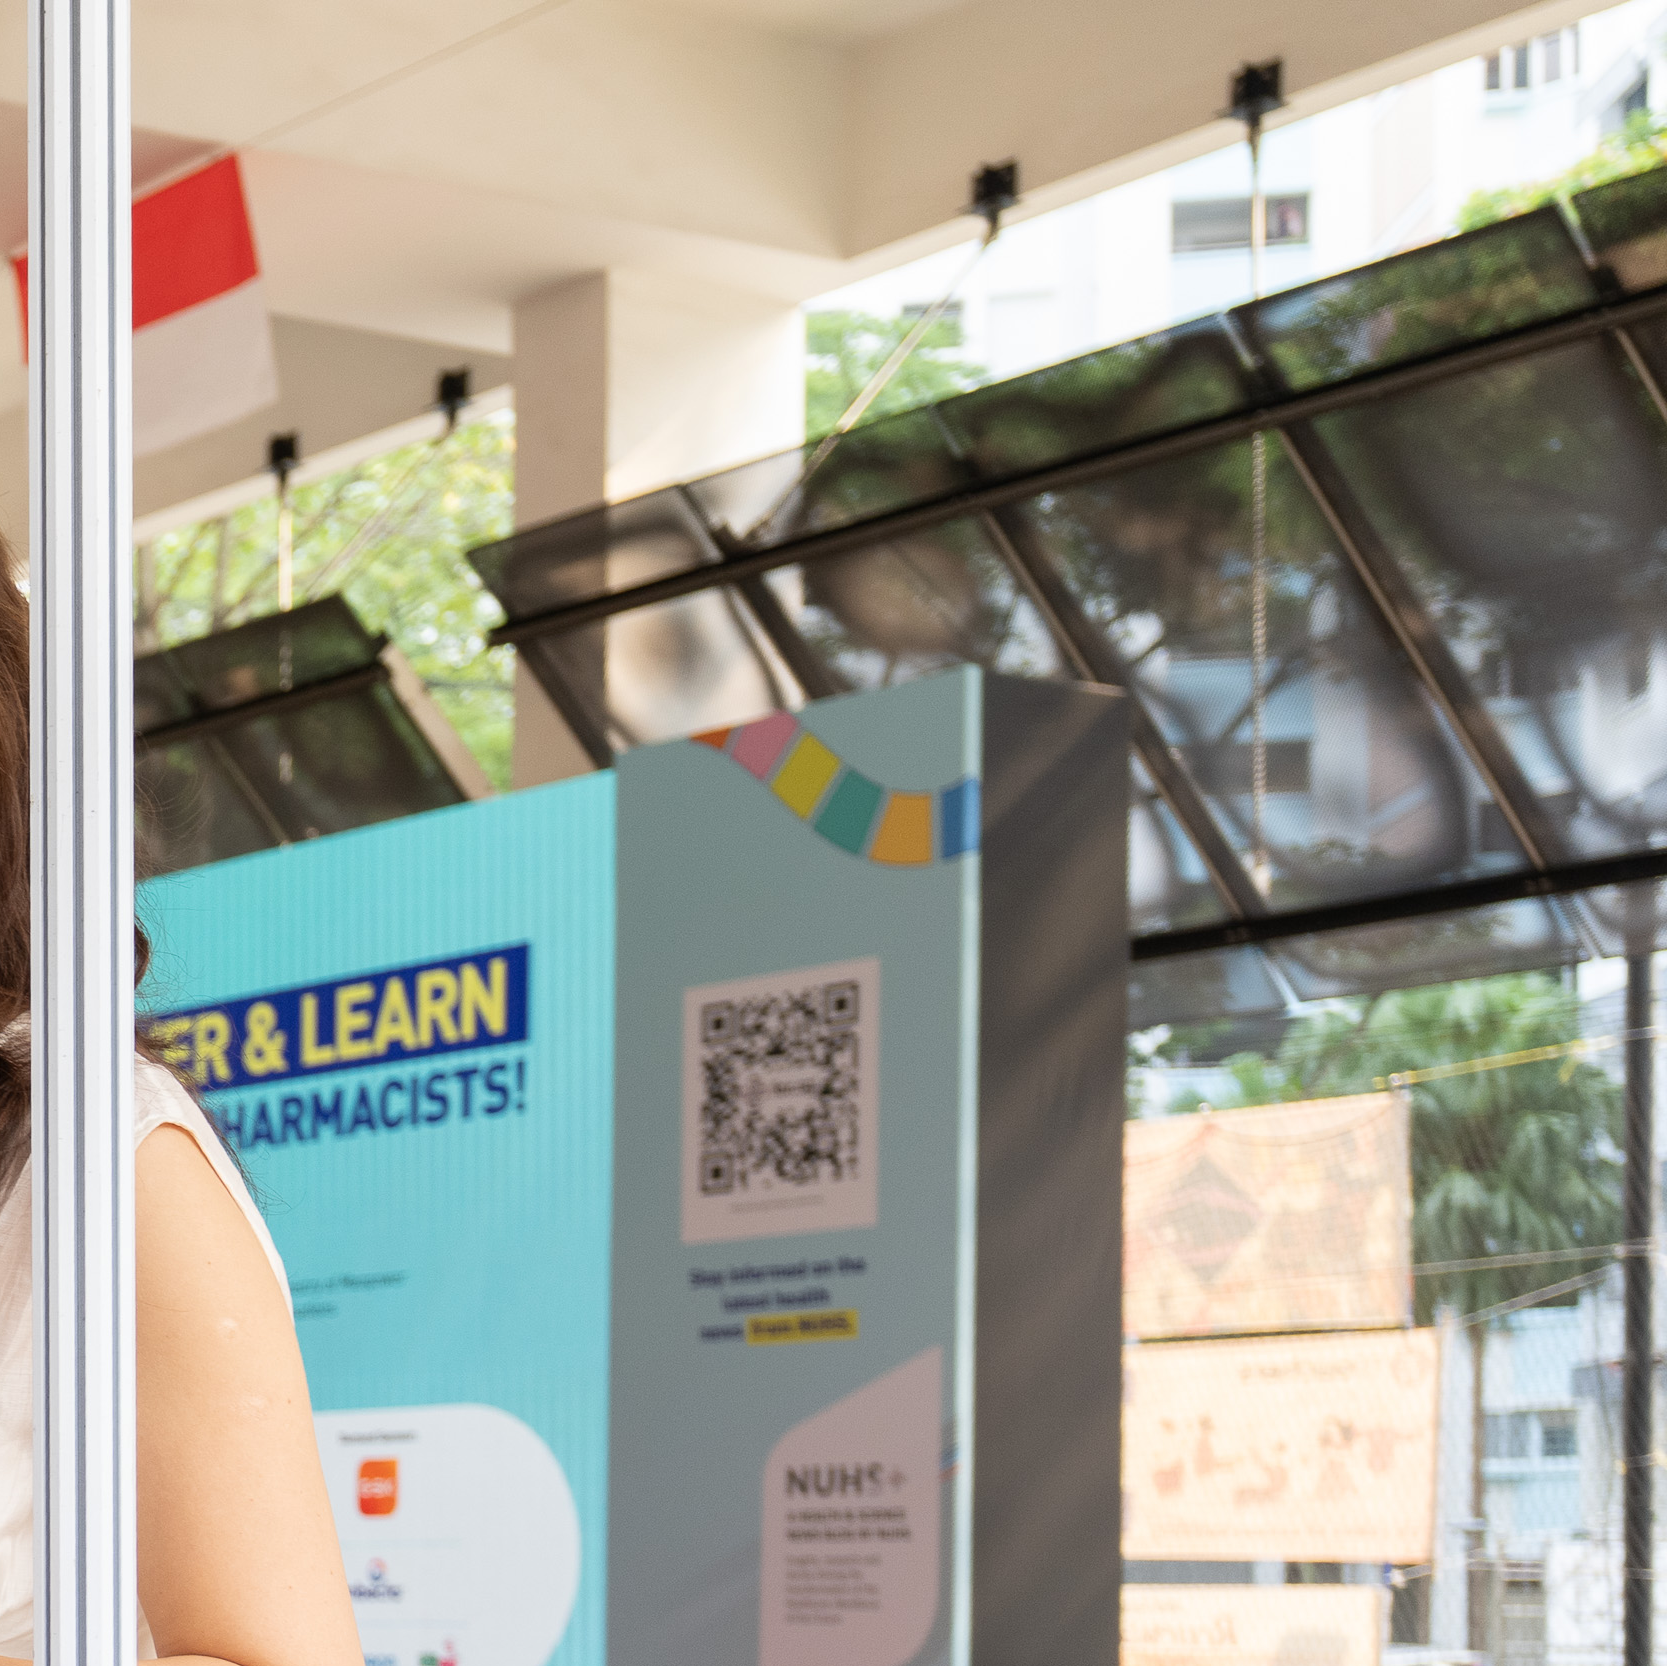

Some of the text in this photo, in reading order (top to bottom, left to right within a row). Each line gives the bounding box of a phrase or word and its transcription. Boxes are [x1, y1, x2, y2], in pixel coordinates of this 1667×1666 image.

[149, 957, 508, 1085] ER & LEARN
[219, 1058, 526, 1153] HARMACISTS!
